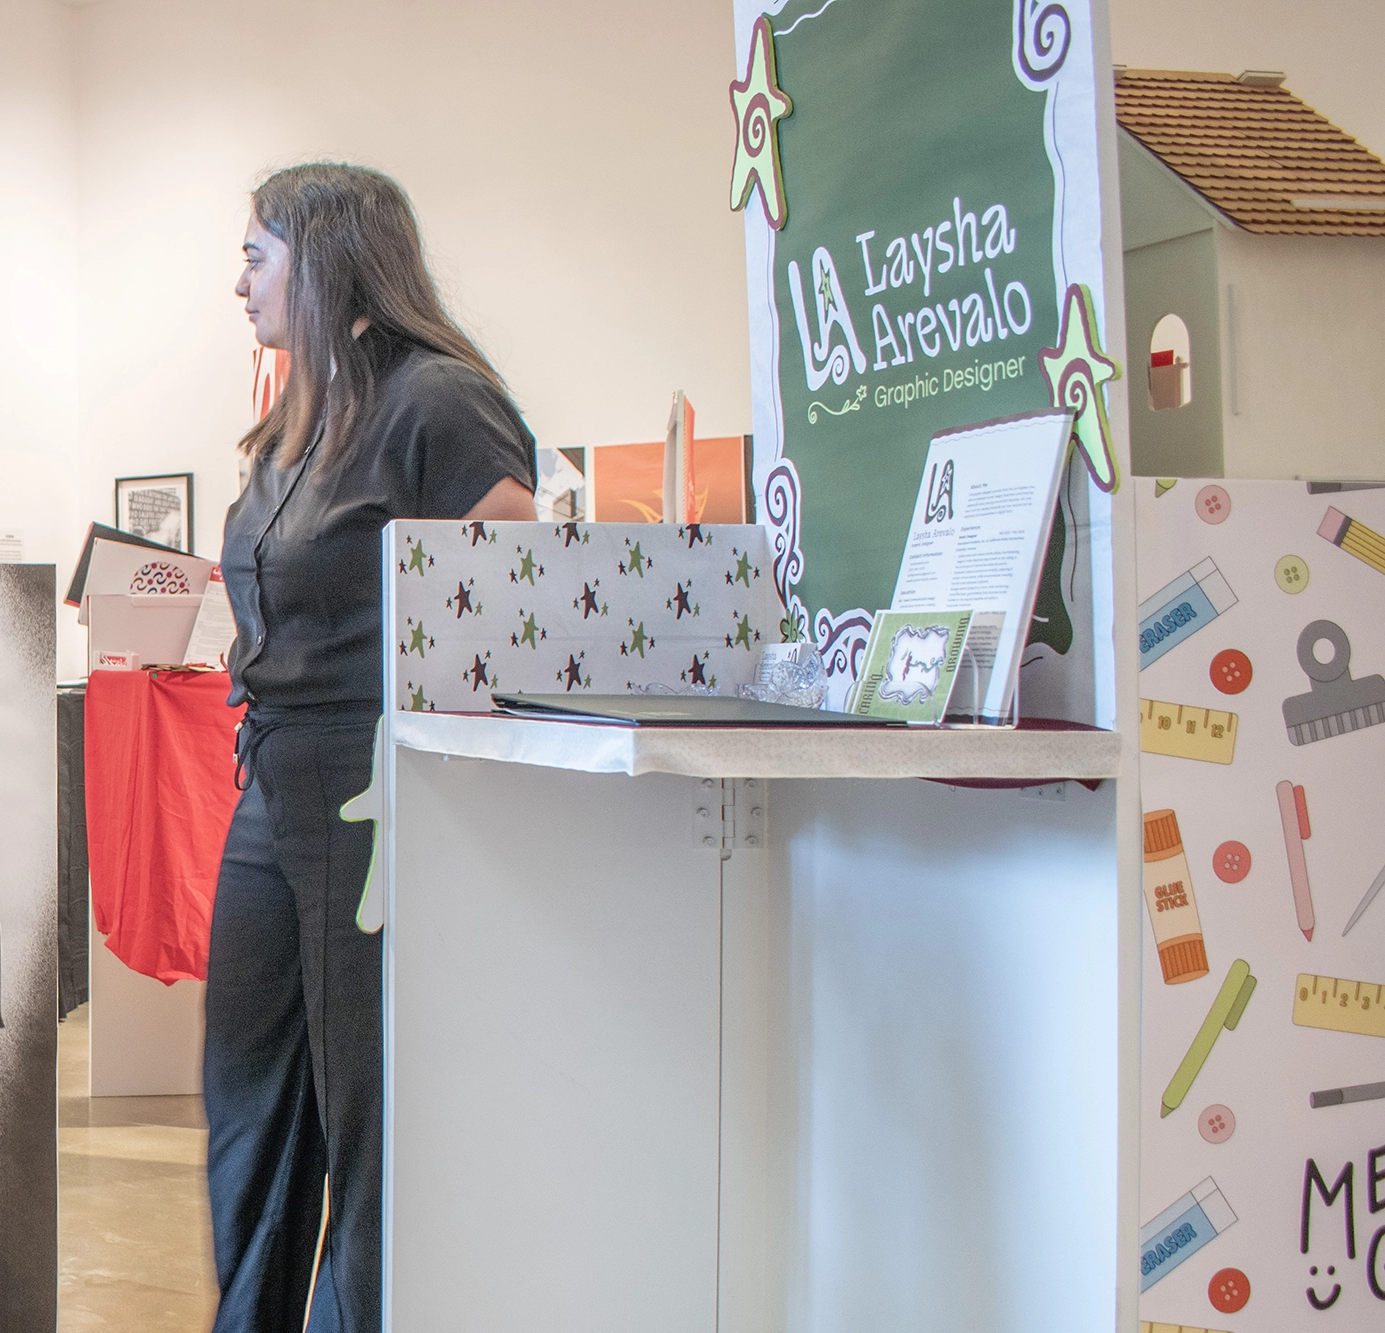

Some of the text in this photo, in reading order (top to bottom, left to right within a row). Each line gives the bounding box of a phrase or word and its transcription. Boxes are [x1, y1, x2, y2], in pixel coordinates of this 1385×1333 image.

[855, 196, 1016, 297] Laysha
[787, 246, 867, 391] LA
[872, 267, 1032, 372] Arevalo
[874, 356, 1026, 409] Graphic Designer
[1138, 602, 1198, 654] ERASER
[1158, 715, 1225, 739] 10 11 12
[1154, 880, 1185, 899] GLUE
[1155, 893, 1189, 913] STICK
[1299, 986, 1371, 1011] 0 1 2 3
[1140, 1222, 1198, 1276] ERASER
